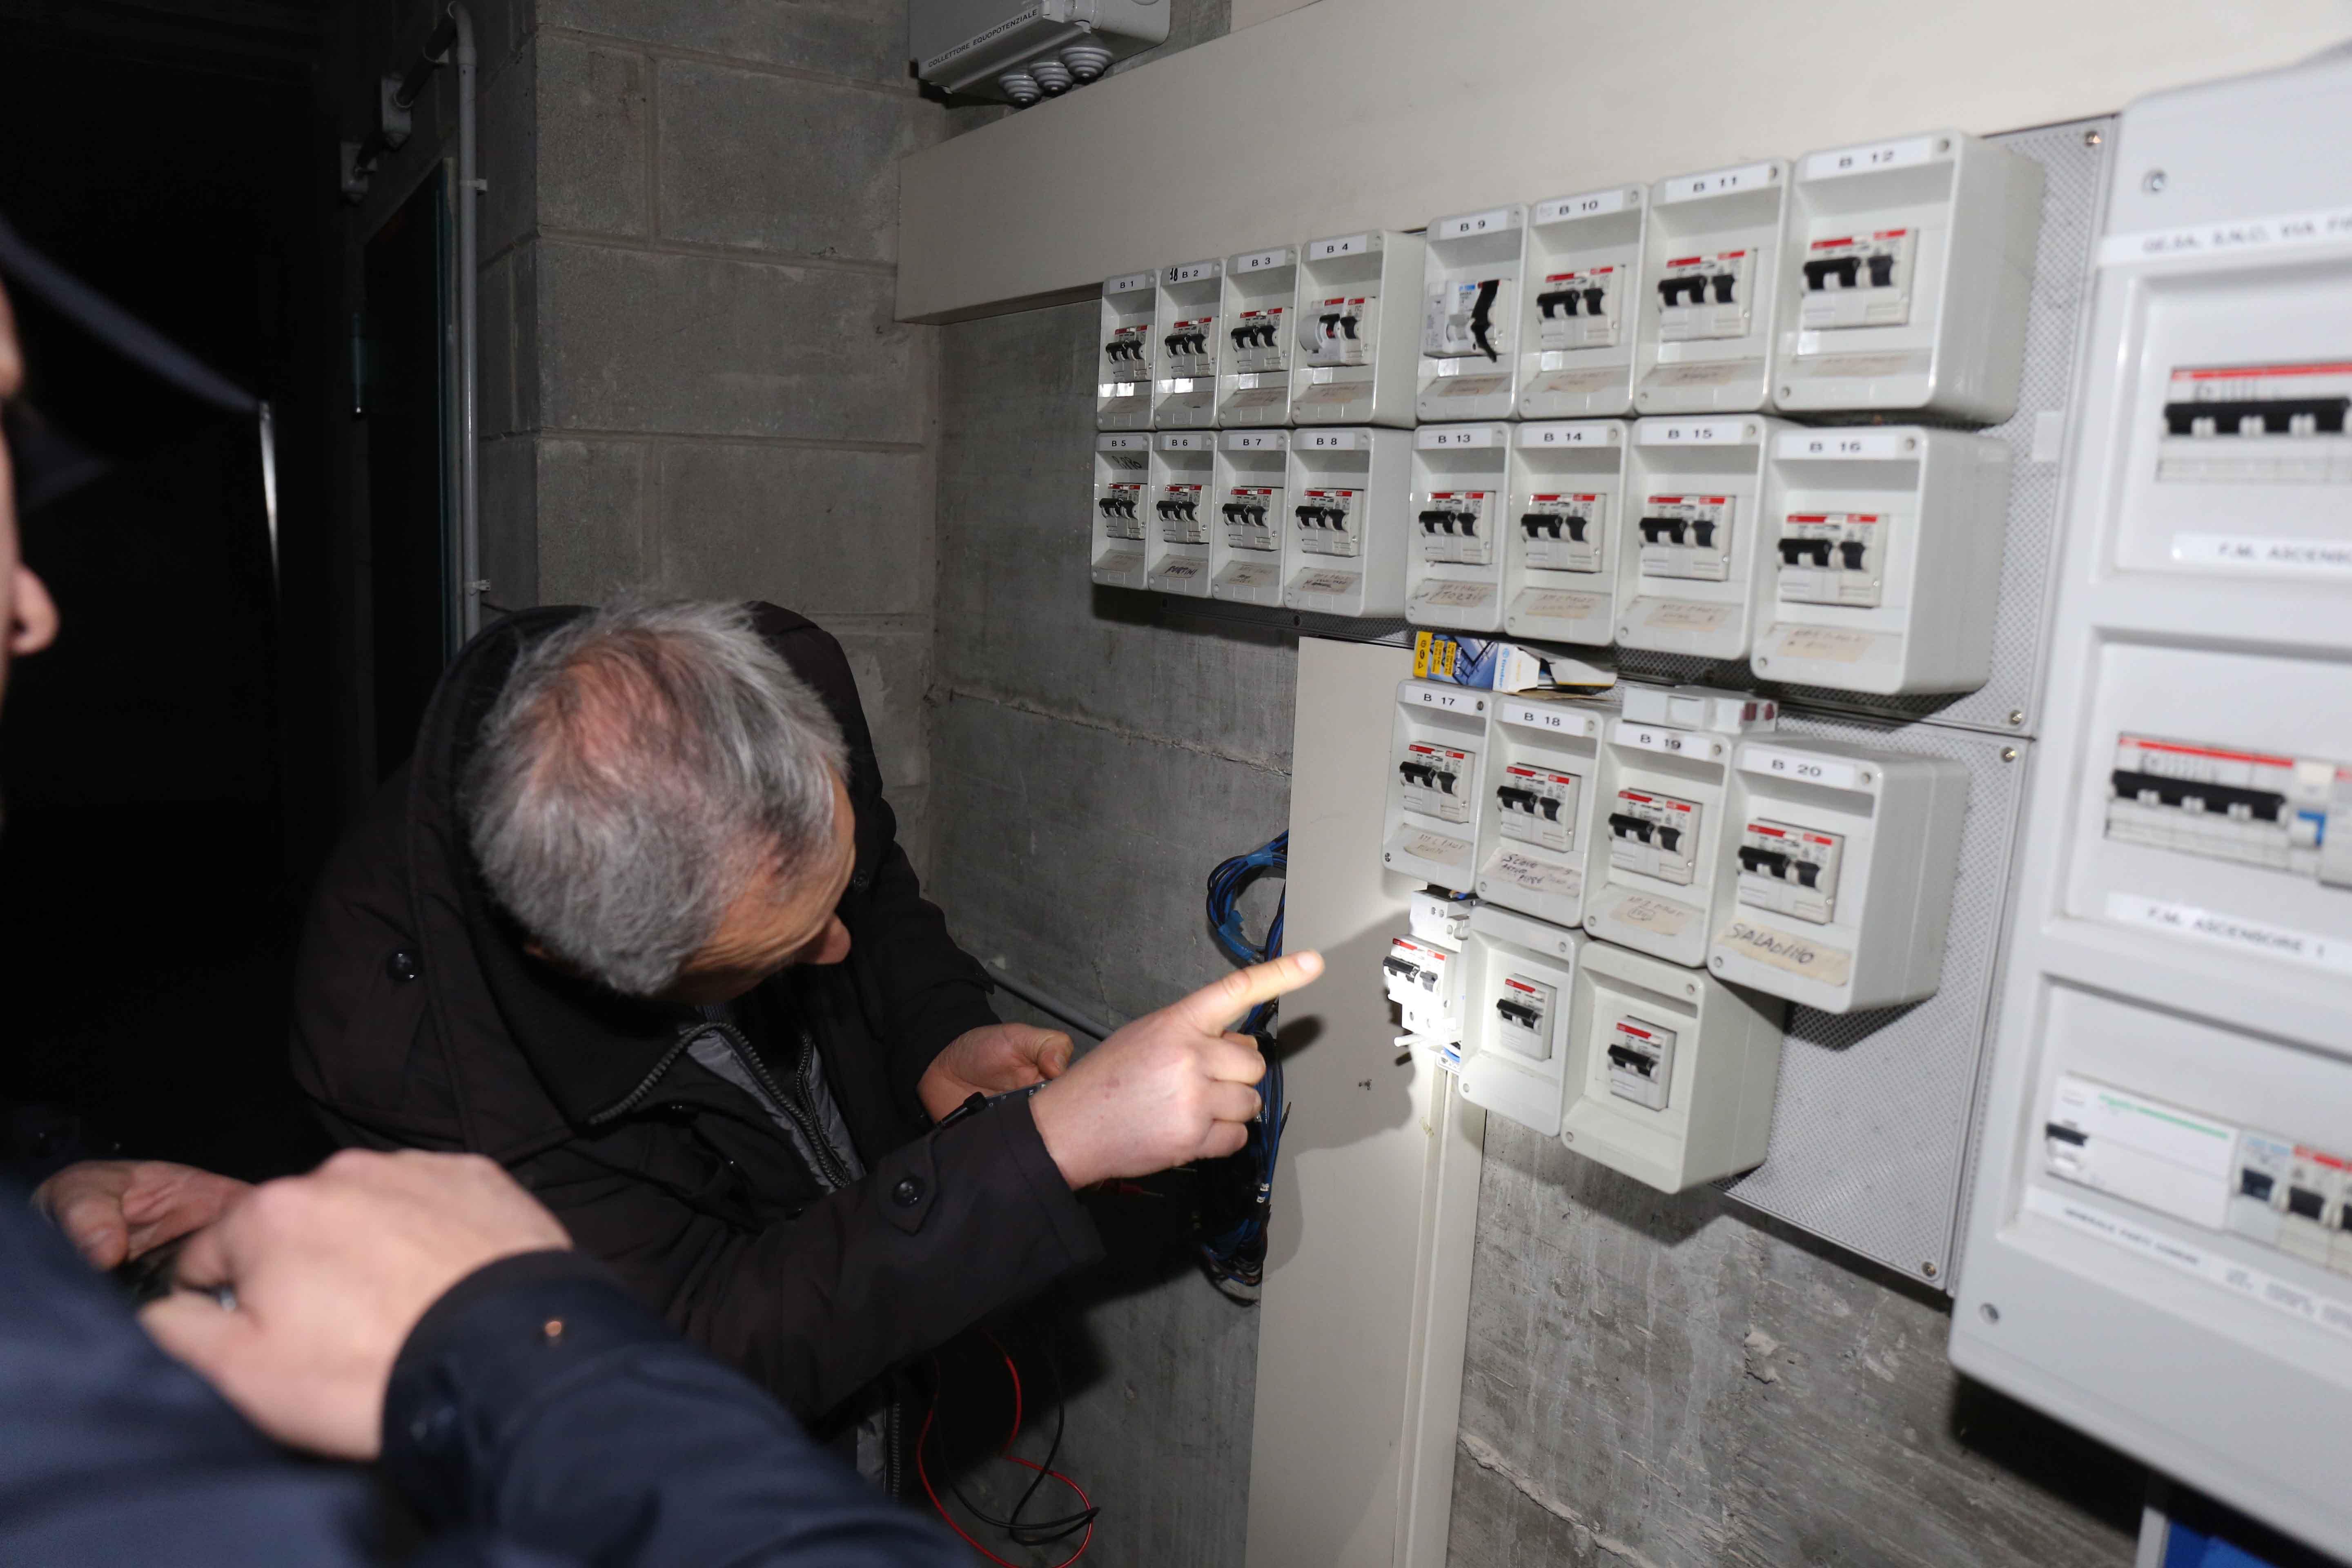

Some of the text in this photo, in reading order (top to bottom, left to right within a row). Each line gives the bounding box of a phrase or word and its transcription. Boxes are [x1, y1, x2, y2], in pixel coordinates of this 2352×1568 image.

[928, 9, 1037, 67] COLLETTORE EQUOPOTENZIALE
[1838, 151, 1894, 167] B 12
[1693, 176, 1736, 192] B 11
[1559, 200, 1598, 215] B 10
[1460, 220, 1486, 232] B 9
[1457, 434, 1470, 443] 13
[1544, 433, 1554, 441] B
[1668, 429, 1712, 439] B 15
[1809, 442, 1861, 452] B 16
[1424, 693, 1455, 706] B 17
[1524, 713, 1560, 726] B 18
[1640, 735, 1682, 750] B 19
[1772, 760, 1821, 777] B 20
